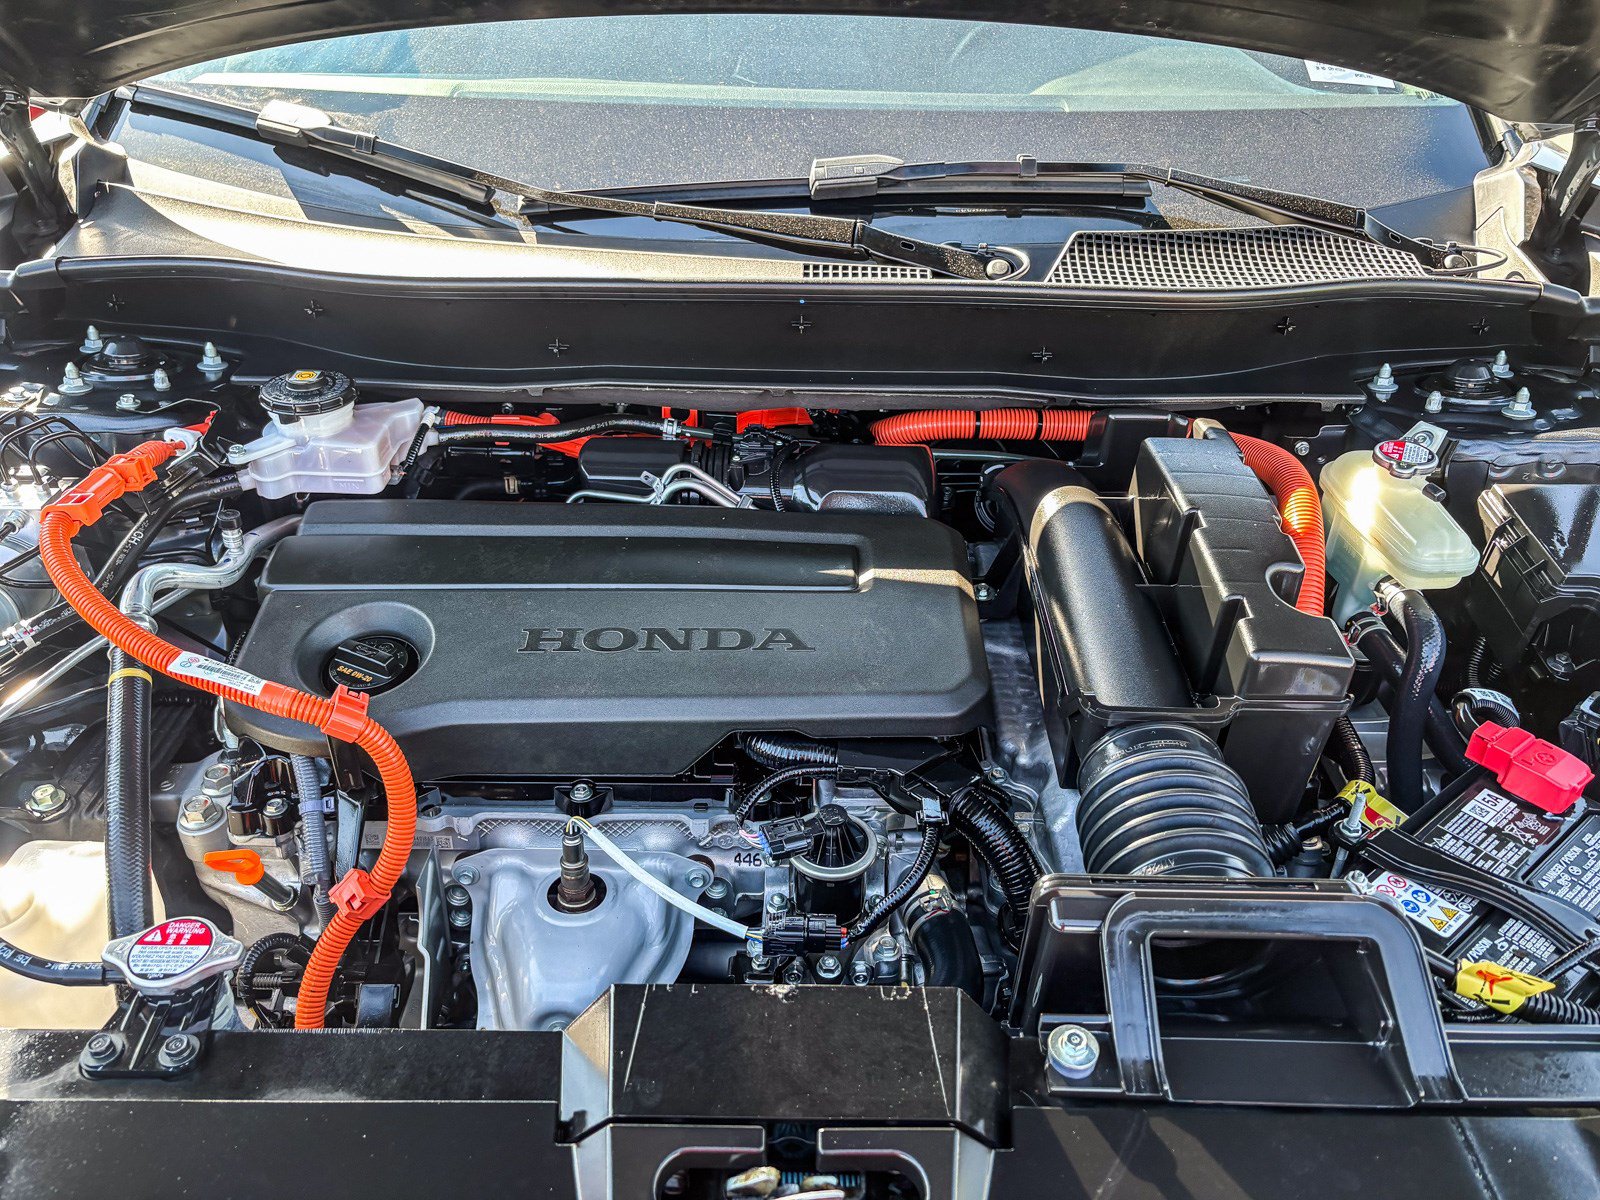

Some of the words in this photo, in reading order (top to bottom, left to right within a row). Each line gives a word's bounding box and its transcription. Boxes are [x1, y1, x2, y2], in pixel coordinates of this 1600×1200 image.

[516, 627, 816, 653] HONDA
[336, 665, 353, 675] SAE
[351, 670, 372, 682] 0W-20
[482, 794, 503, 807] 5A
[734, 852, 762, 867] 446
